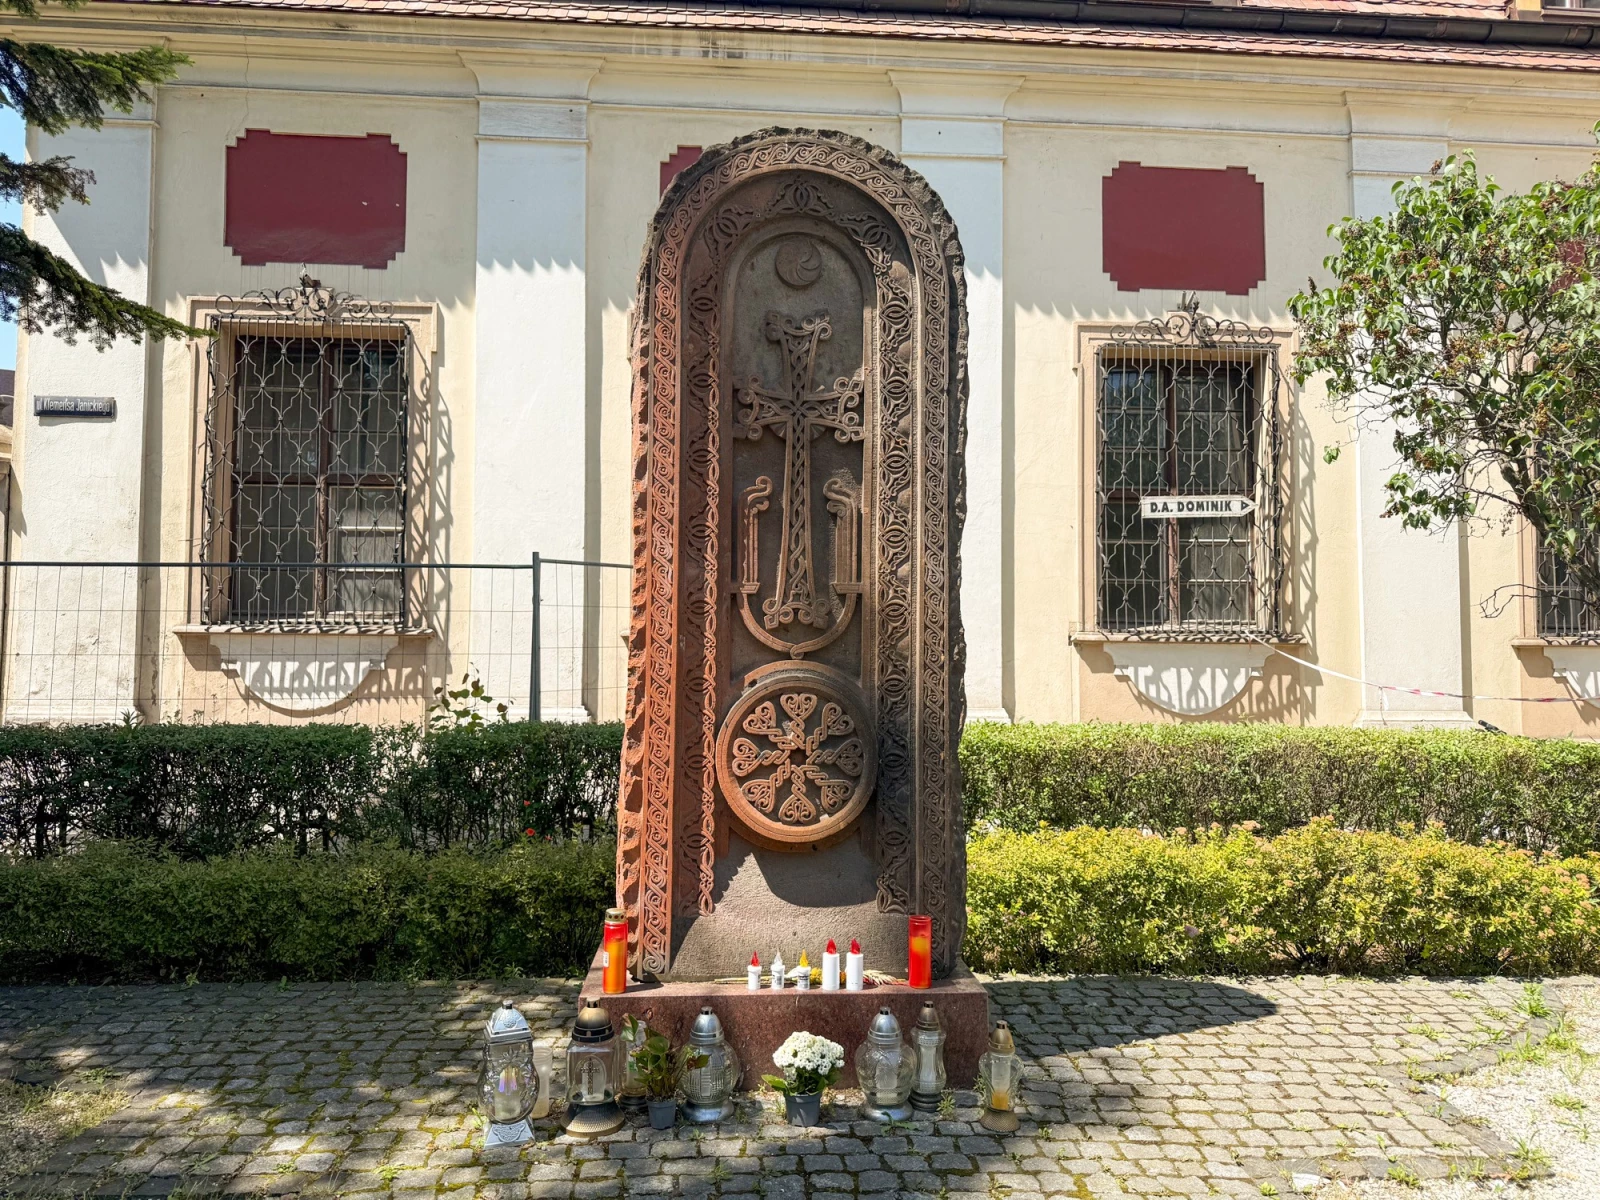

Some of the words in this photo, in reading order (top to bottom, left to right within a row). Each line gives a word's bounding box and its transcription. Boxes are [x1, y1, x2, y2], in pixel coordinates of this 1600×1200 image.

[76, 399, 110, 415] Janickiego
[1150, 502, 1173, 513] D.A.
[1177, 501, 1232, 512] DOMINIK
